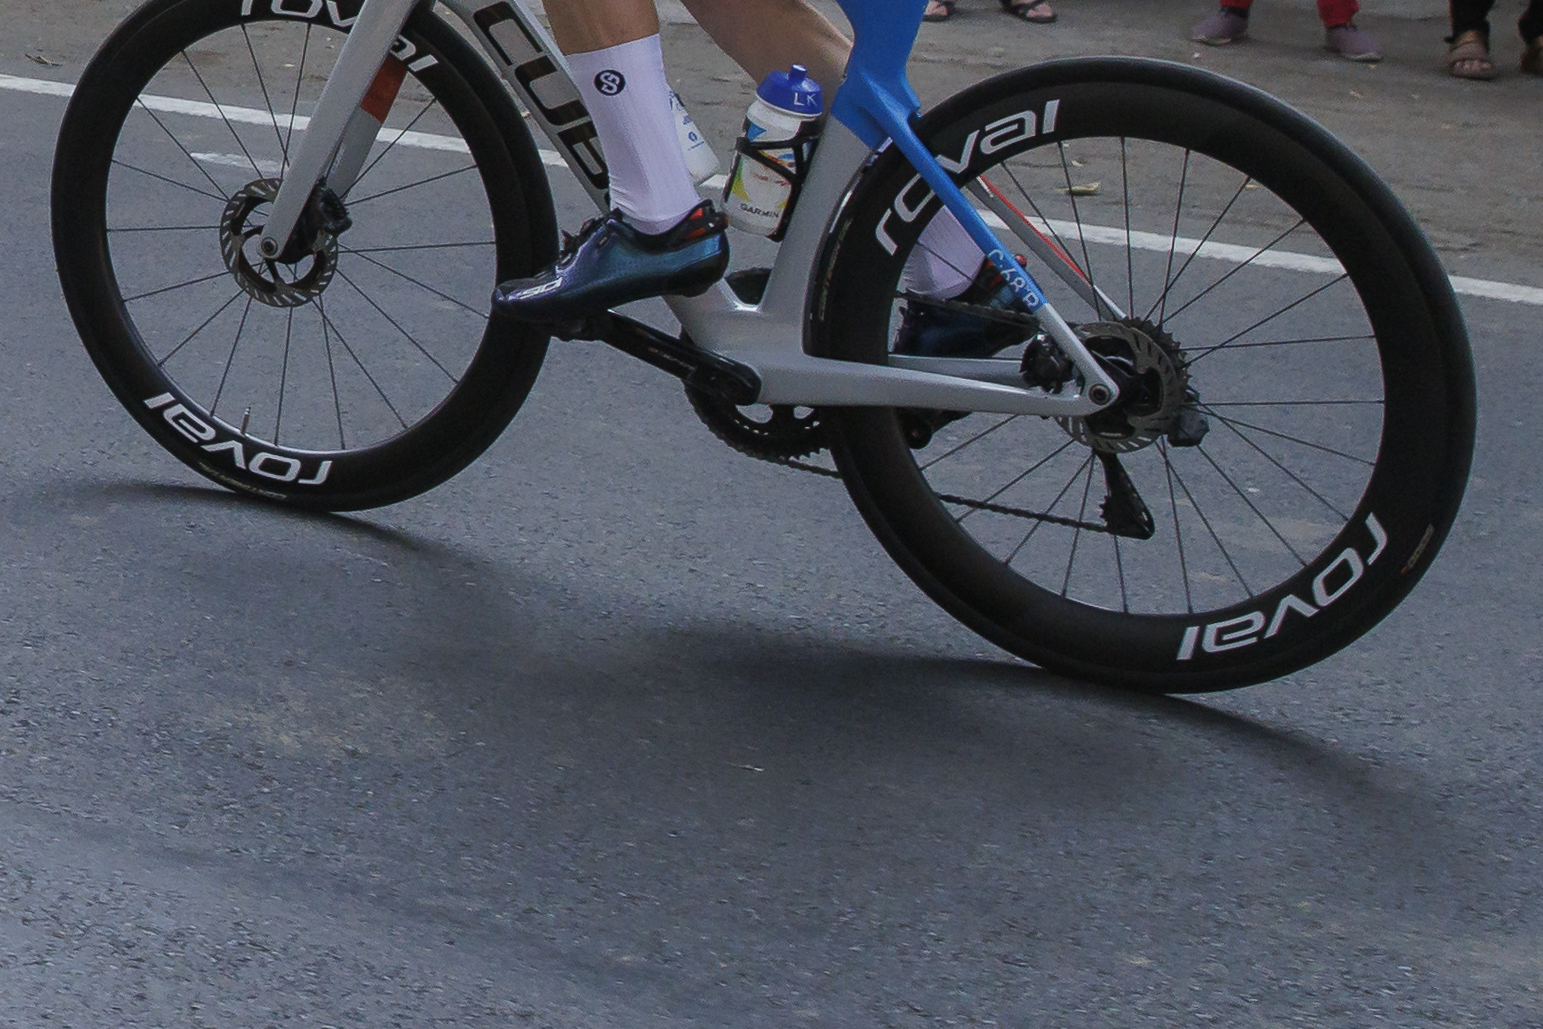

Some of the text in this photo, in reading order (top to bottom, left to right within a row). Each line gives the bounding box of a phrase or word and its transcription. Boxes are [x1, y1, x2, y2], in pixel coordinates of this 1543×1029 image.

[473, 0, 611, 196] CUB
[739, 203, 780, 220] GARMIN
[143, 392, 335, 486] roval
[1175, 512, 1390, 661] roval
